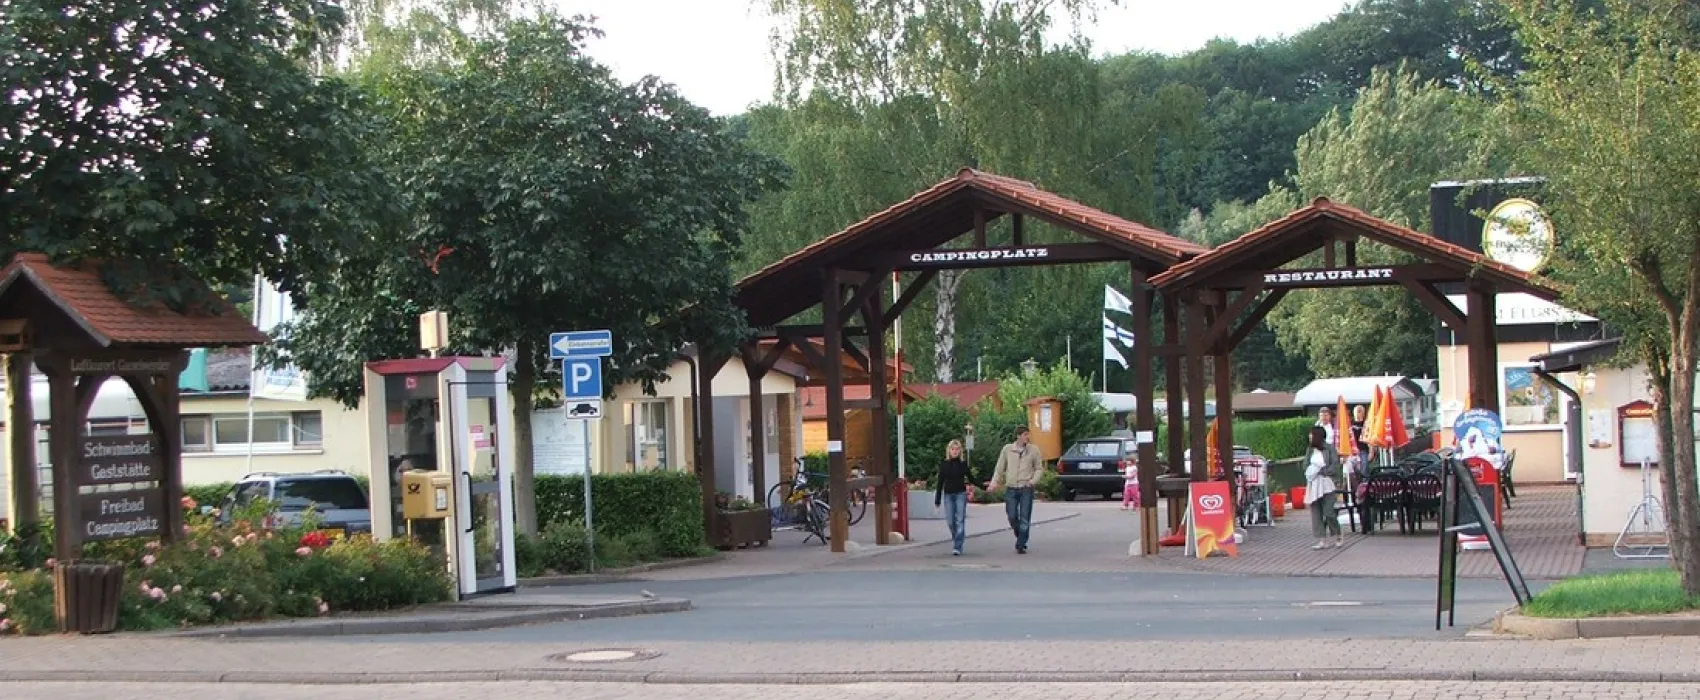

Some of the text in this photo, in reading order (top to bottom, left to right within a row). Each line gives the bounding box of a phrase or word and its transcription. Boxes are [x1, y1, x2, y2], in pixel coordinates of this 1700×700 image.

[910, 248, 1048, 262] CAMPINGPLATZ
[1264, 269, 1393, 283] RESTAURANT
[572, 363, 593, 394] P
[101, 497, 145, 514] Freibad
